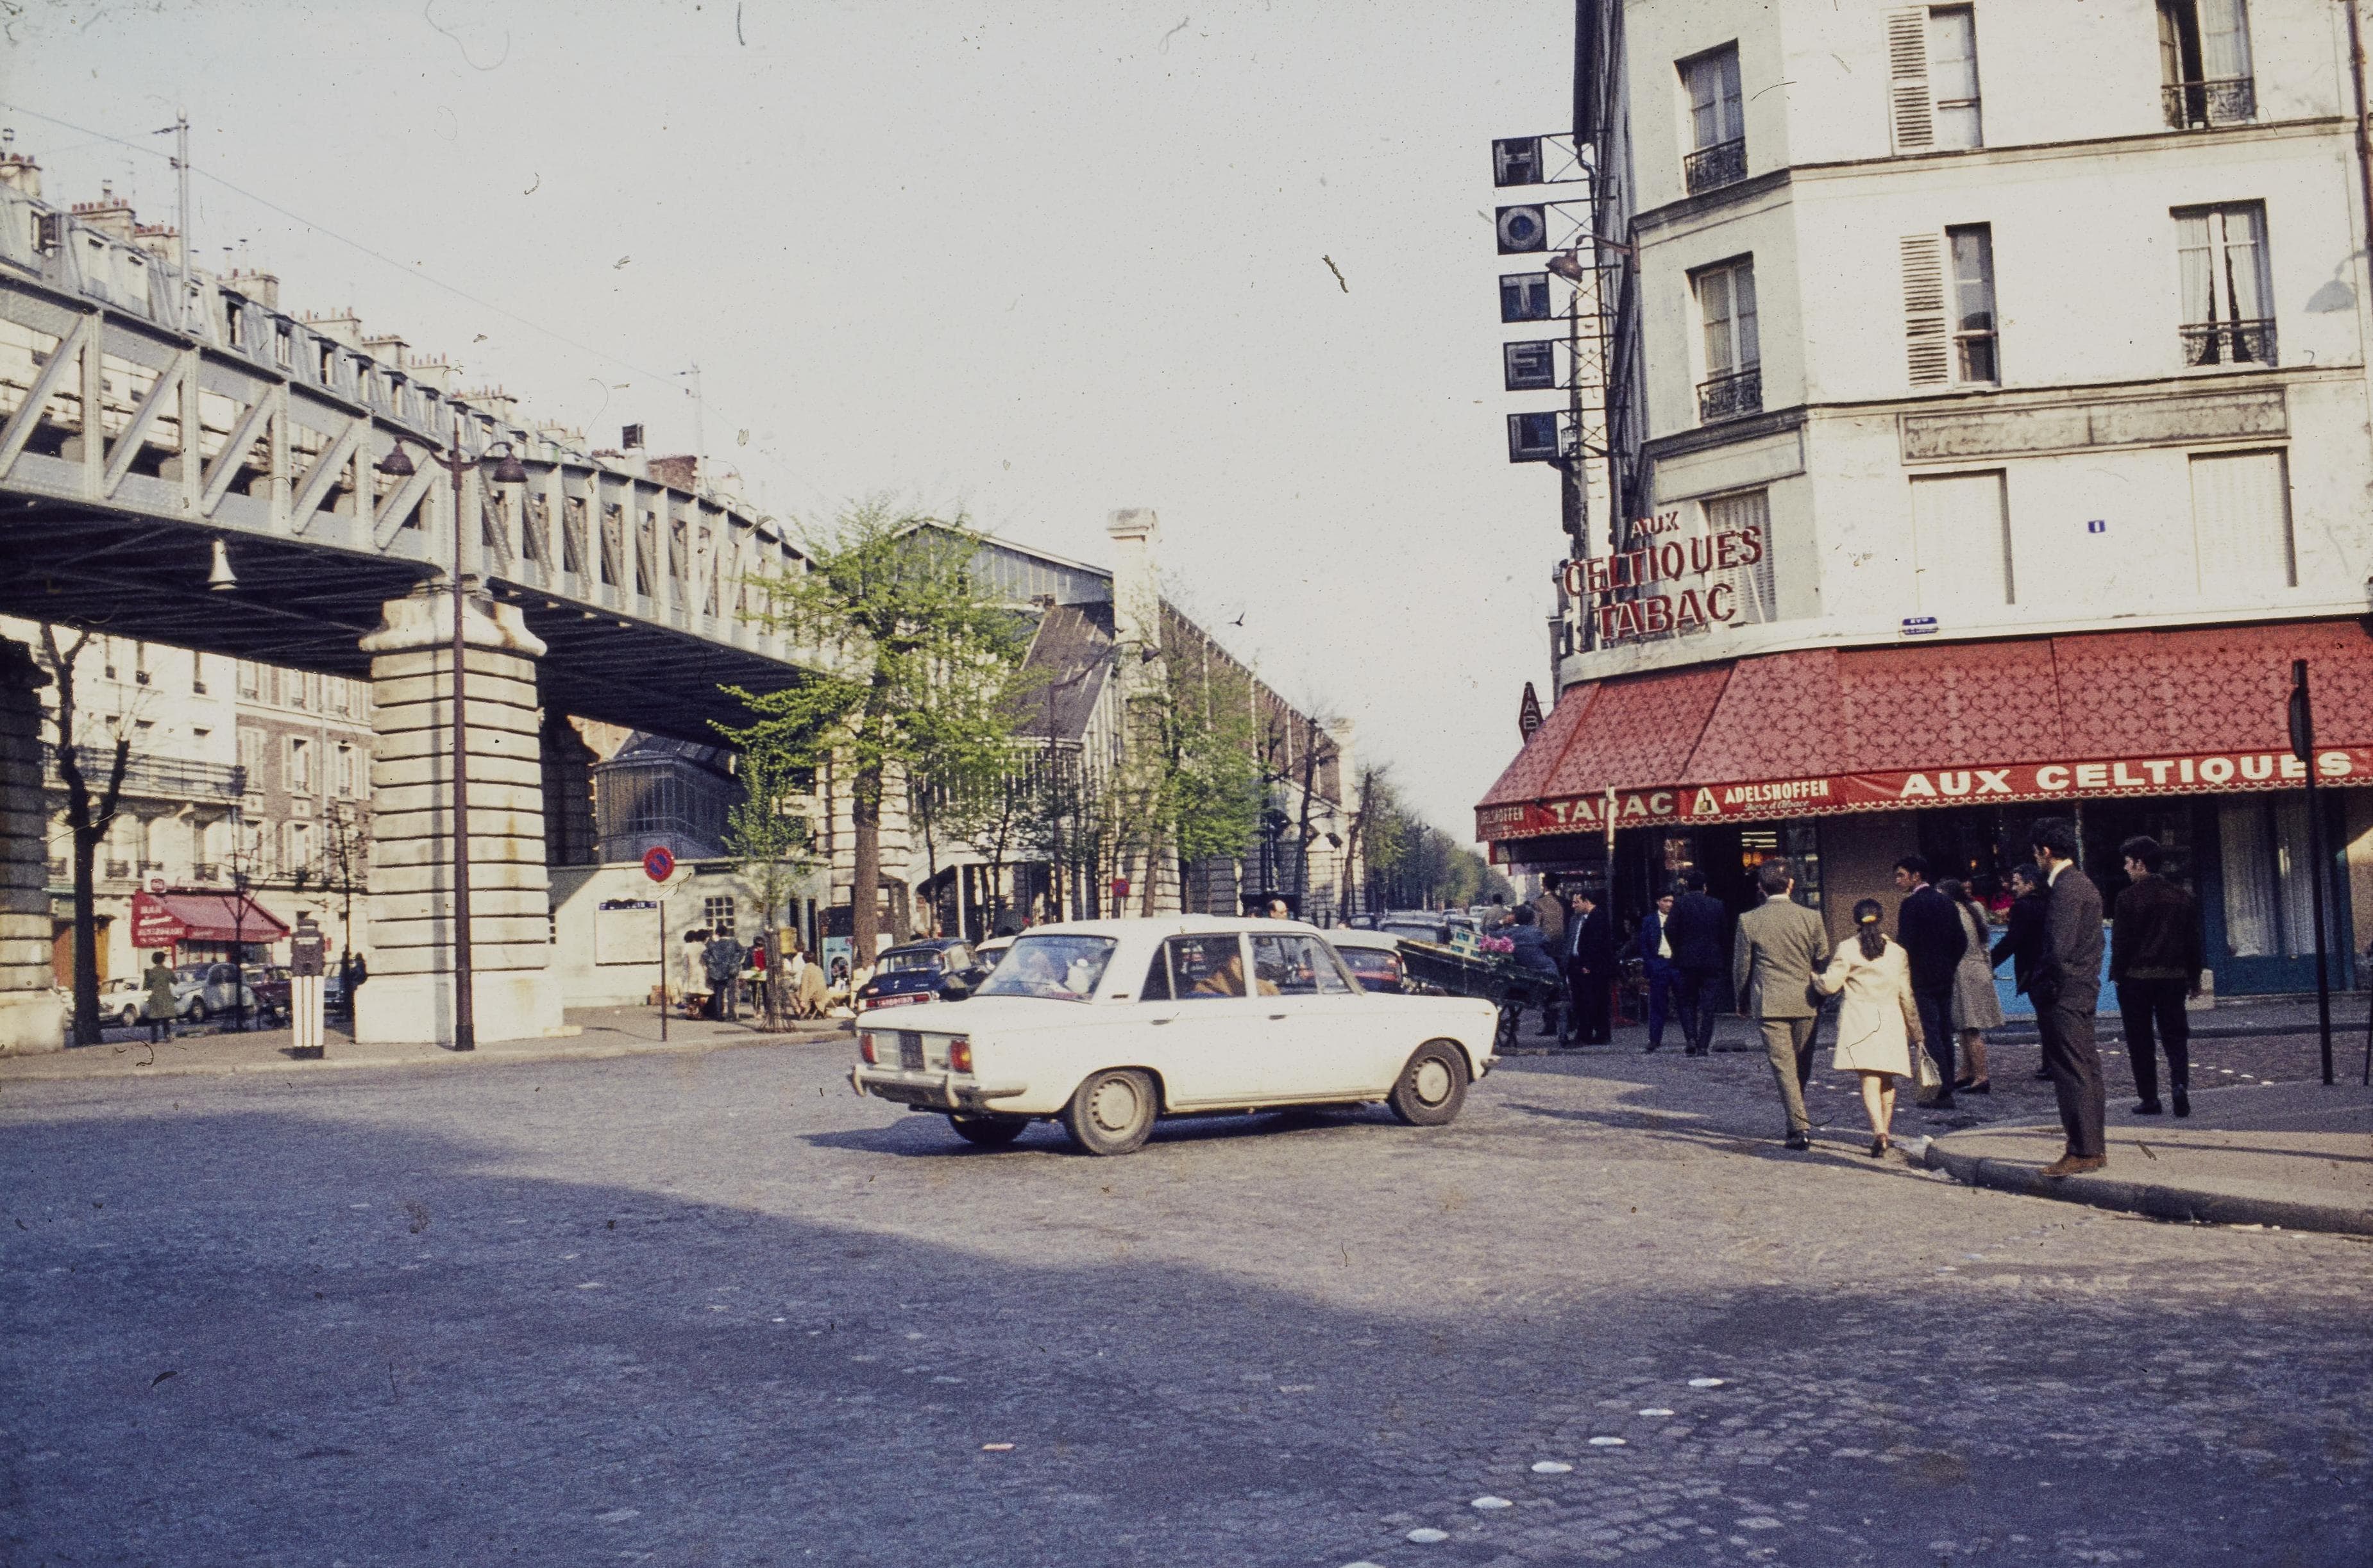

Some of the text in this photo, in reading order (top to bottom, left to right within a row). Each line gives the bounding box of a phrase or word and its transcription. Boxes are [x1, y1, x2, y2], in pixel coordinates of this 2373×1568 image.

[1497, 137, 1557, 457] HOTEL
[1632, 511, 1680, 538] AUX
[1564, 525, 1762, 596] CELTIQUES
[1599, 583, 1735, 641] TABAC
[1725, 780, 1828, 804] ADELSHOFFEN
[1900, 751, 2352, 798] AUX CELTIQUES
[1551, 792, 1673, 823] TABAC
